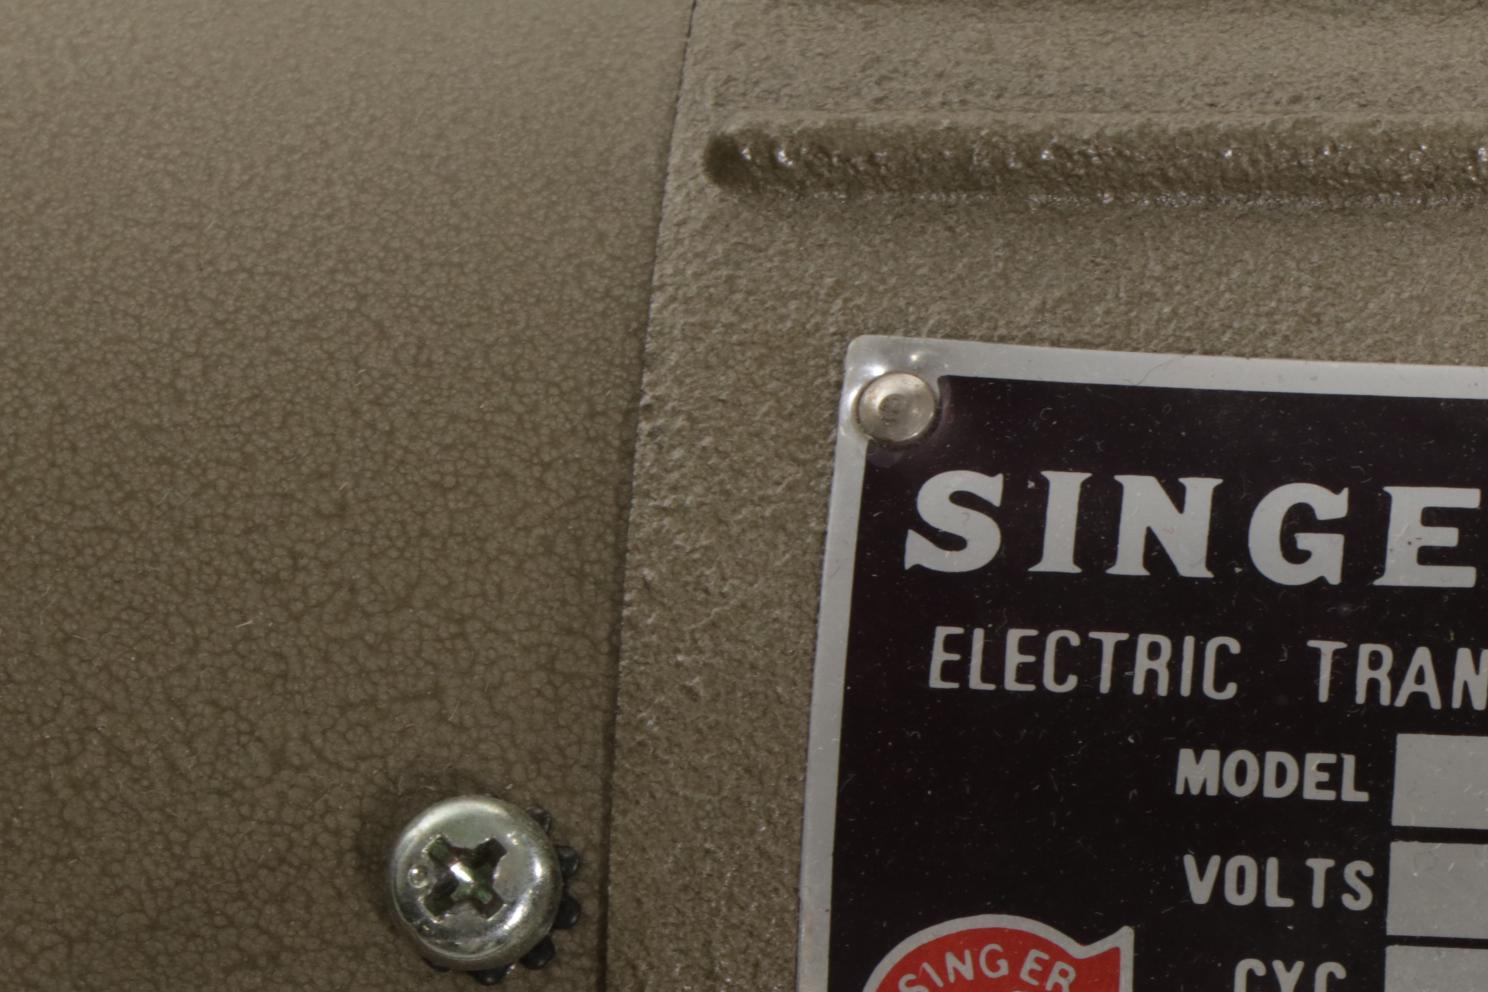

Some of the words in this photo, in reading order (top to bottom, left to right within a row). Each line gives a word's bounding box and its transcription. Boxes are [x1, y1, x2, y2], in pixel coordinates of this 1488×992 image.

[928, 625, 1241, 701] ELECTRIC
[1174, 748, 1370, 803] MODEL
[1182, 854, 1374, 910] VOLTS
